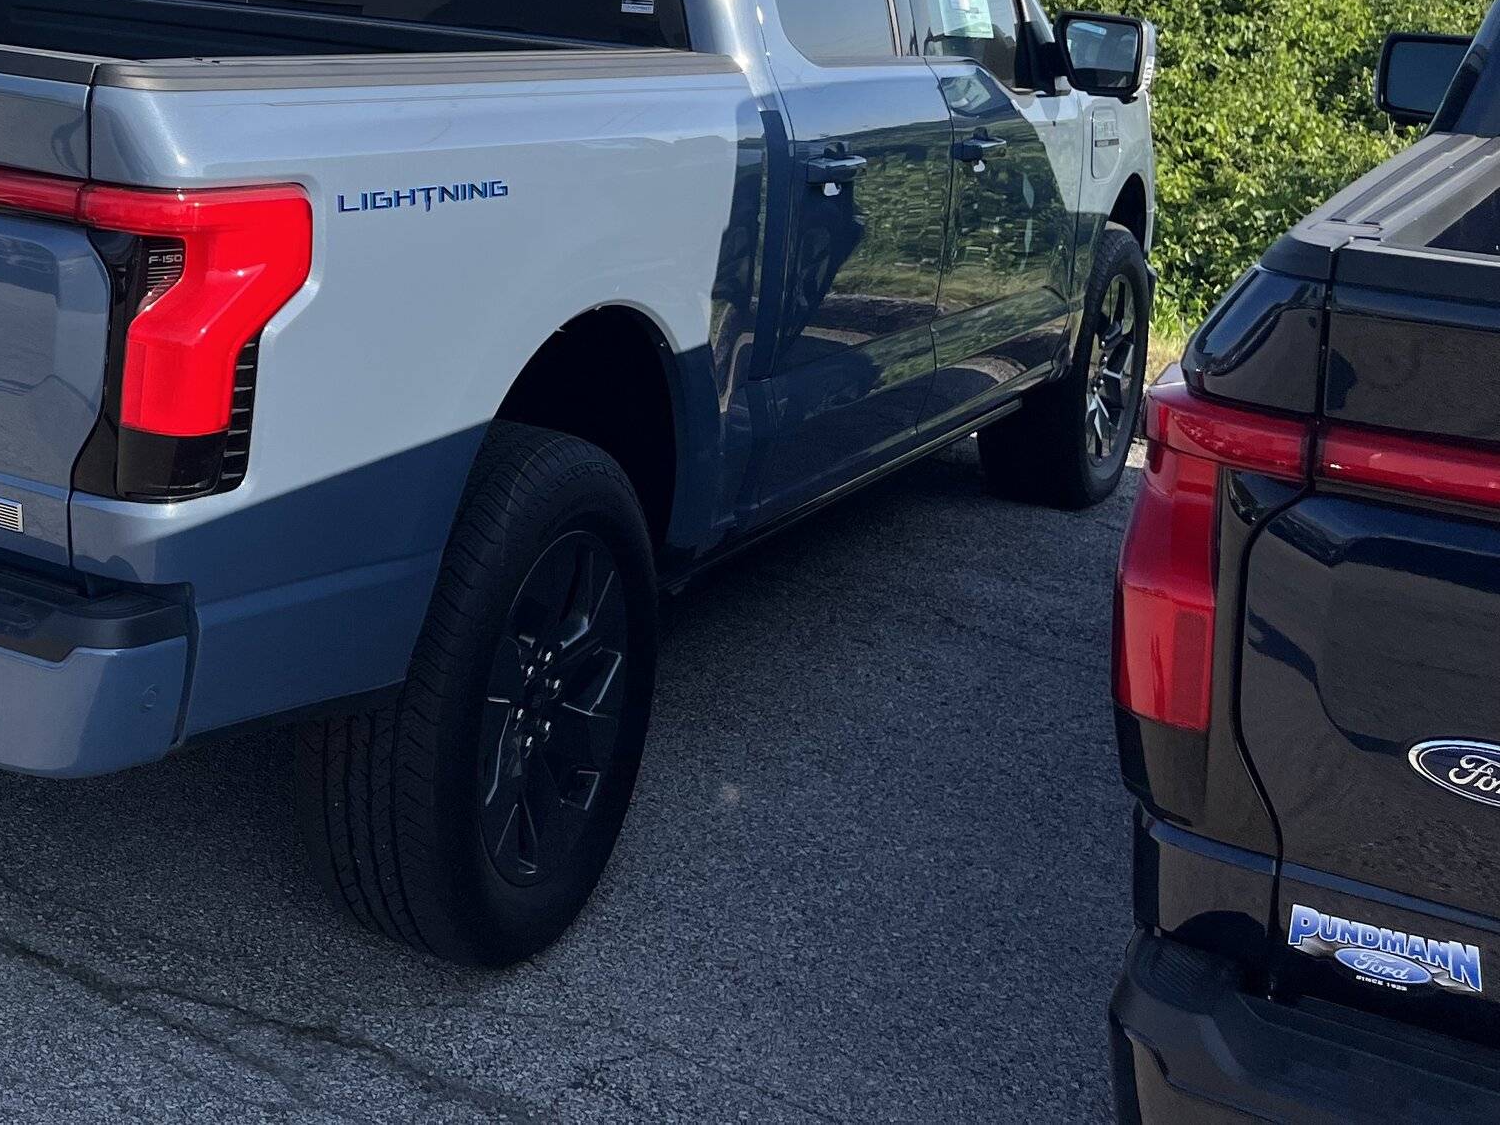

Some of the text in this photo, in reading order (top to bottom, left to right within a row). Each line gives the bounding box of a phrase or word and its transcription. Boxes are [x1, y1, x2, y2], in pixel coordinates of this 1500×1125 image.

[336, 180, 509, 213] LIGHTNING
[148, 254, 183, 265] F-150
[1448, 754, 1500, 794] Fo
[1288, 903, 1483, 993] PUNDMANN
[1353, 952, 1408, 981] Ford
